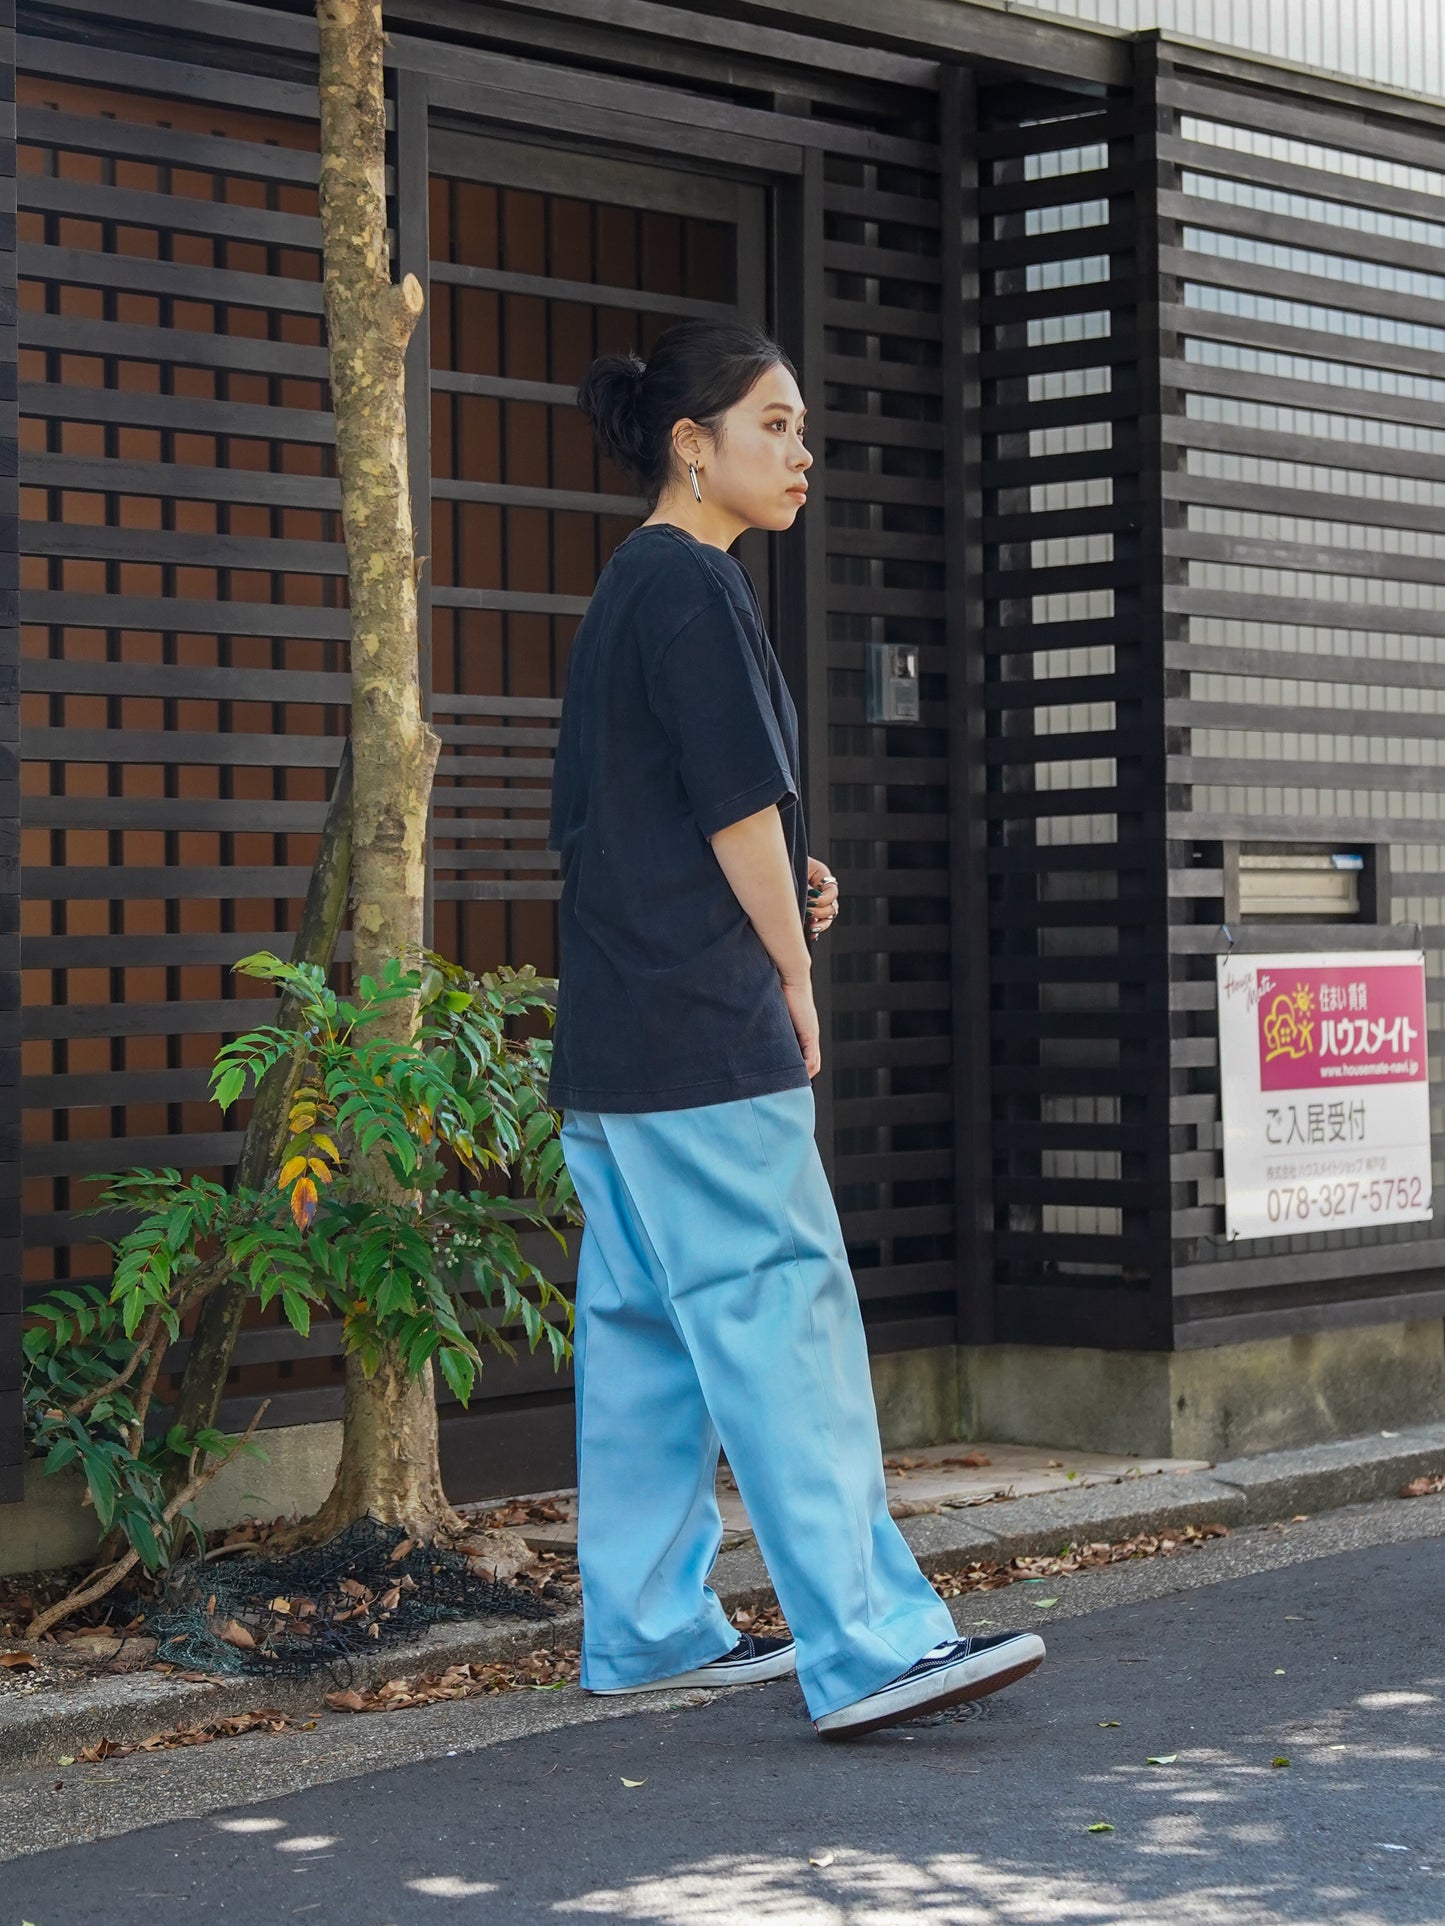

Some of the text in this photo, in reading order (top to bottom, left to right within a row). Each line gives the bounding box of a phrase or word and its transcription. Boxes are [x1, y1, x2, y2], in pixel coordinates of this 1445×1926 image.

[1247, 975, 1276, 1012] Mate
[1319, 983, 1347, 1012] 住まい
[1319, 1016, 1417, 1056] ハウスメイト
[1320, 1061, 1419, 1078] www.housemate-navi.jp
[1266, 1099, 1365, 1144] ご入居受付
[1267, 1176, 1422, 1222] 078-327-5752
